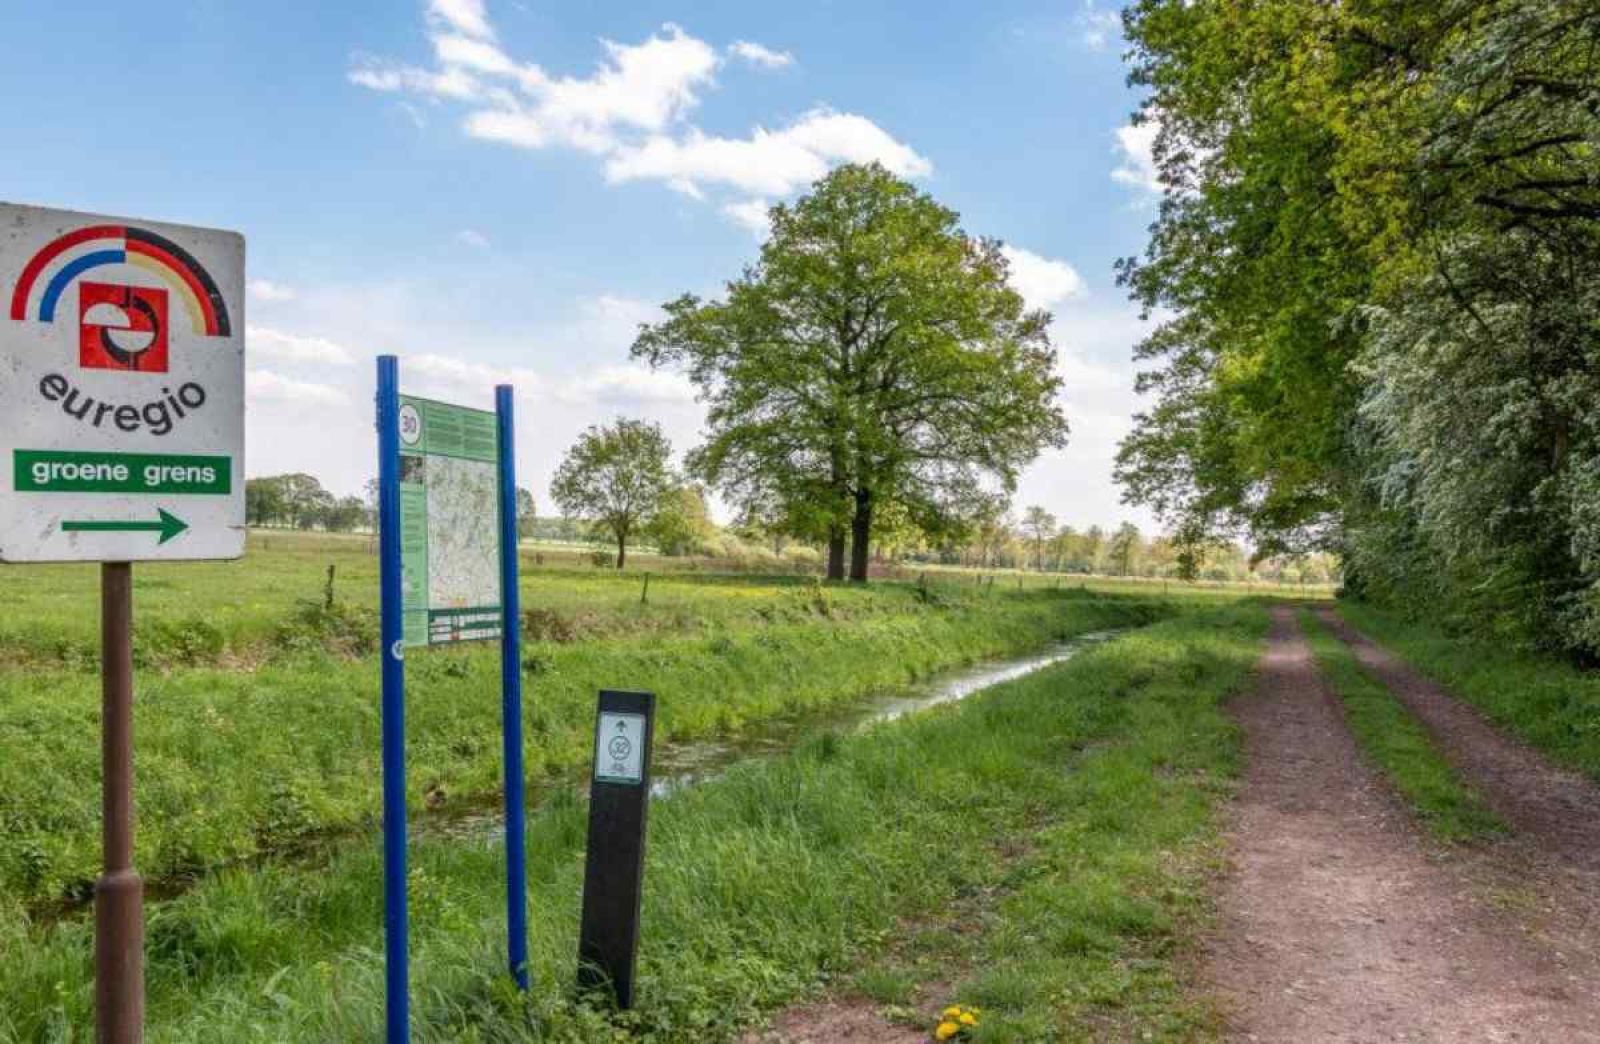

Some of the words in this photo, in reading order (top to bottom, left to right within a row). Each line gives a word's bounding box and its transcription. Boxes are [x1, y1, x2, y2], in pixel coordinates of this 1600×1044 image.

[39, 373, 206, 436] euregio
[32, 460, 128, 484] groene
[143, 463, 216, 485] grens
